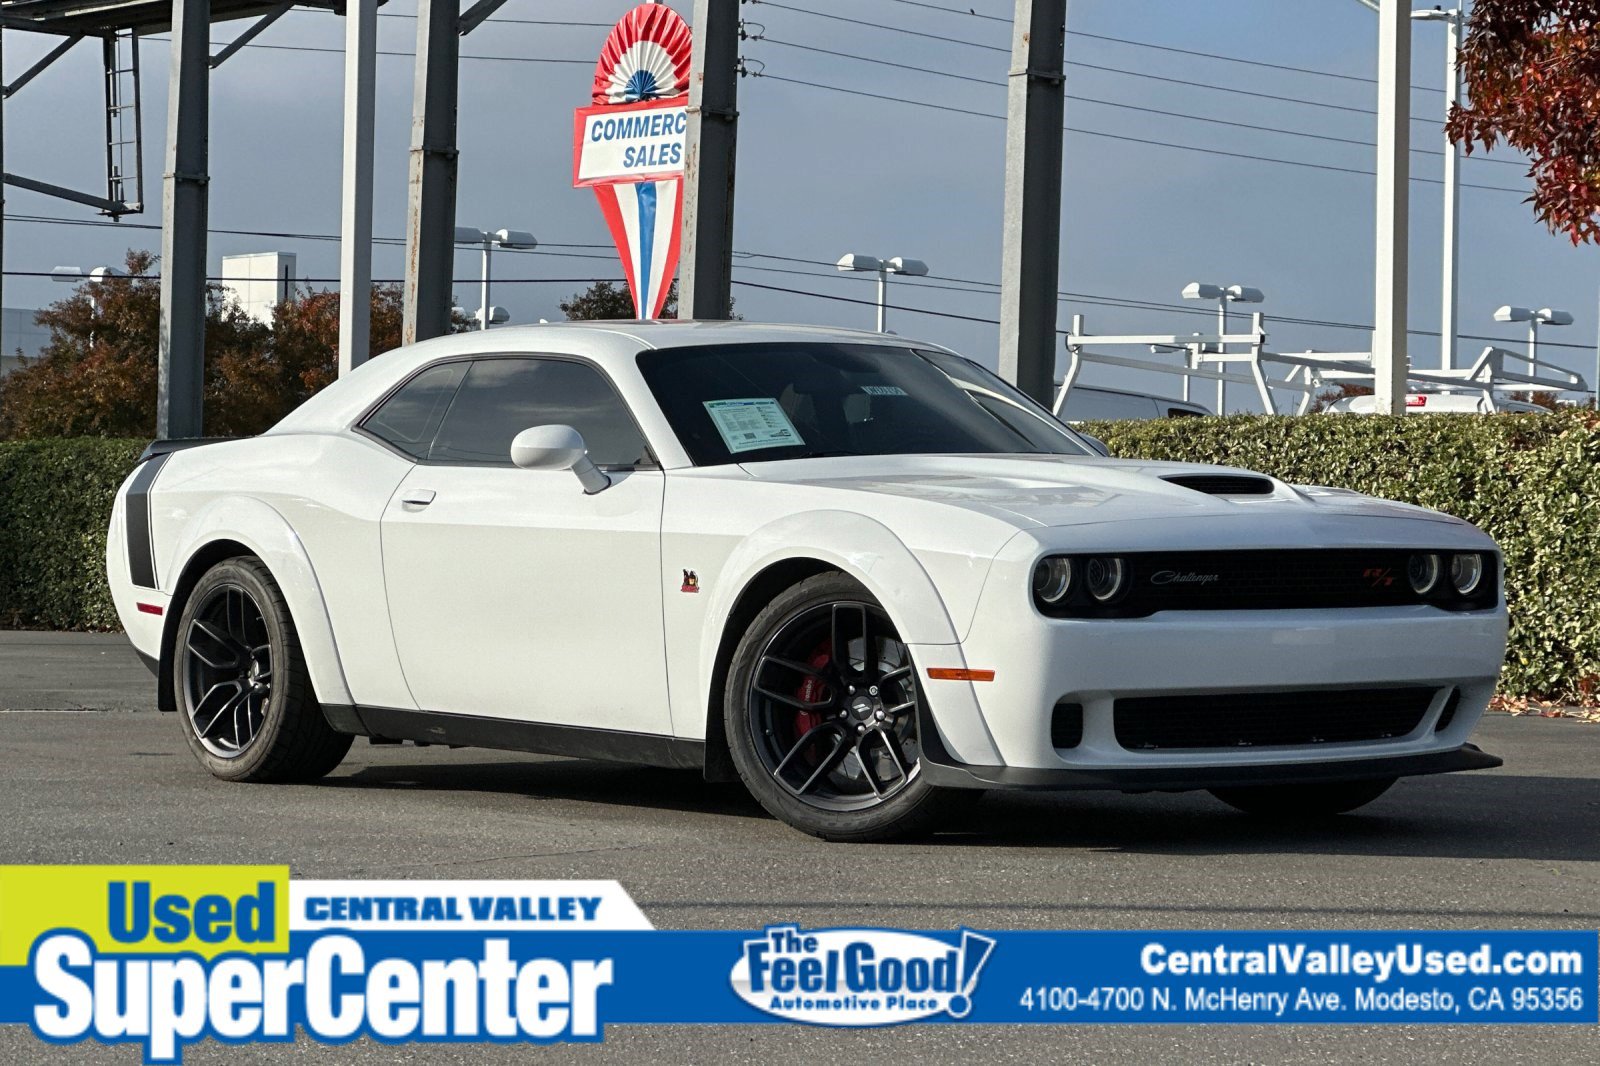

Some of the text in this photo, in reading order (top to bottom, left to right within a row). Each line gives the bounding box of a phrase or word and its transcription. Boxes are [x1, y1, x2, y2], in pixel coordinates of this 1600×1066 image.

[591, 112, 686, 142] COMMERC
[623, 142, 682, 168] SALES
[1150, 570, 1219, 586] Challenger
